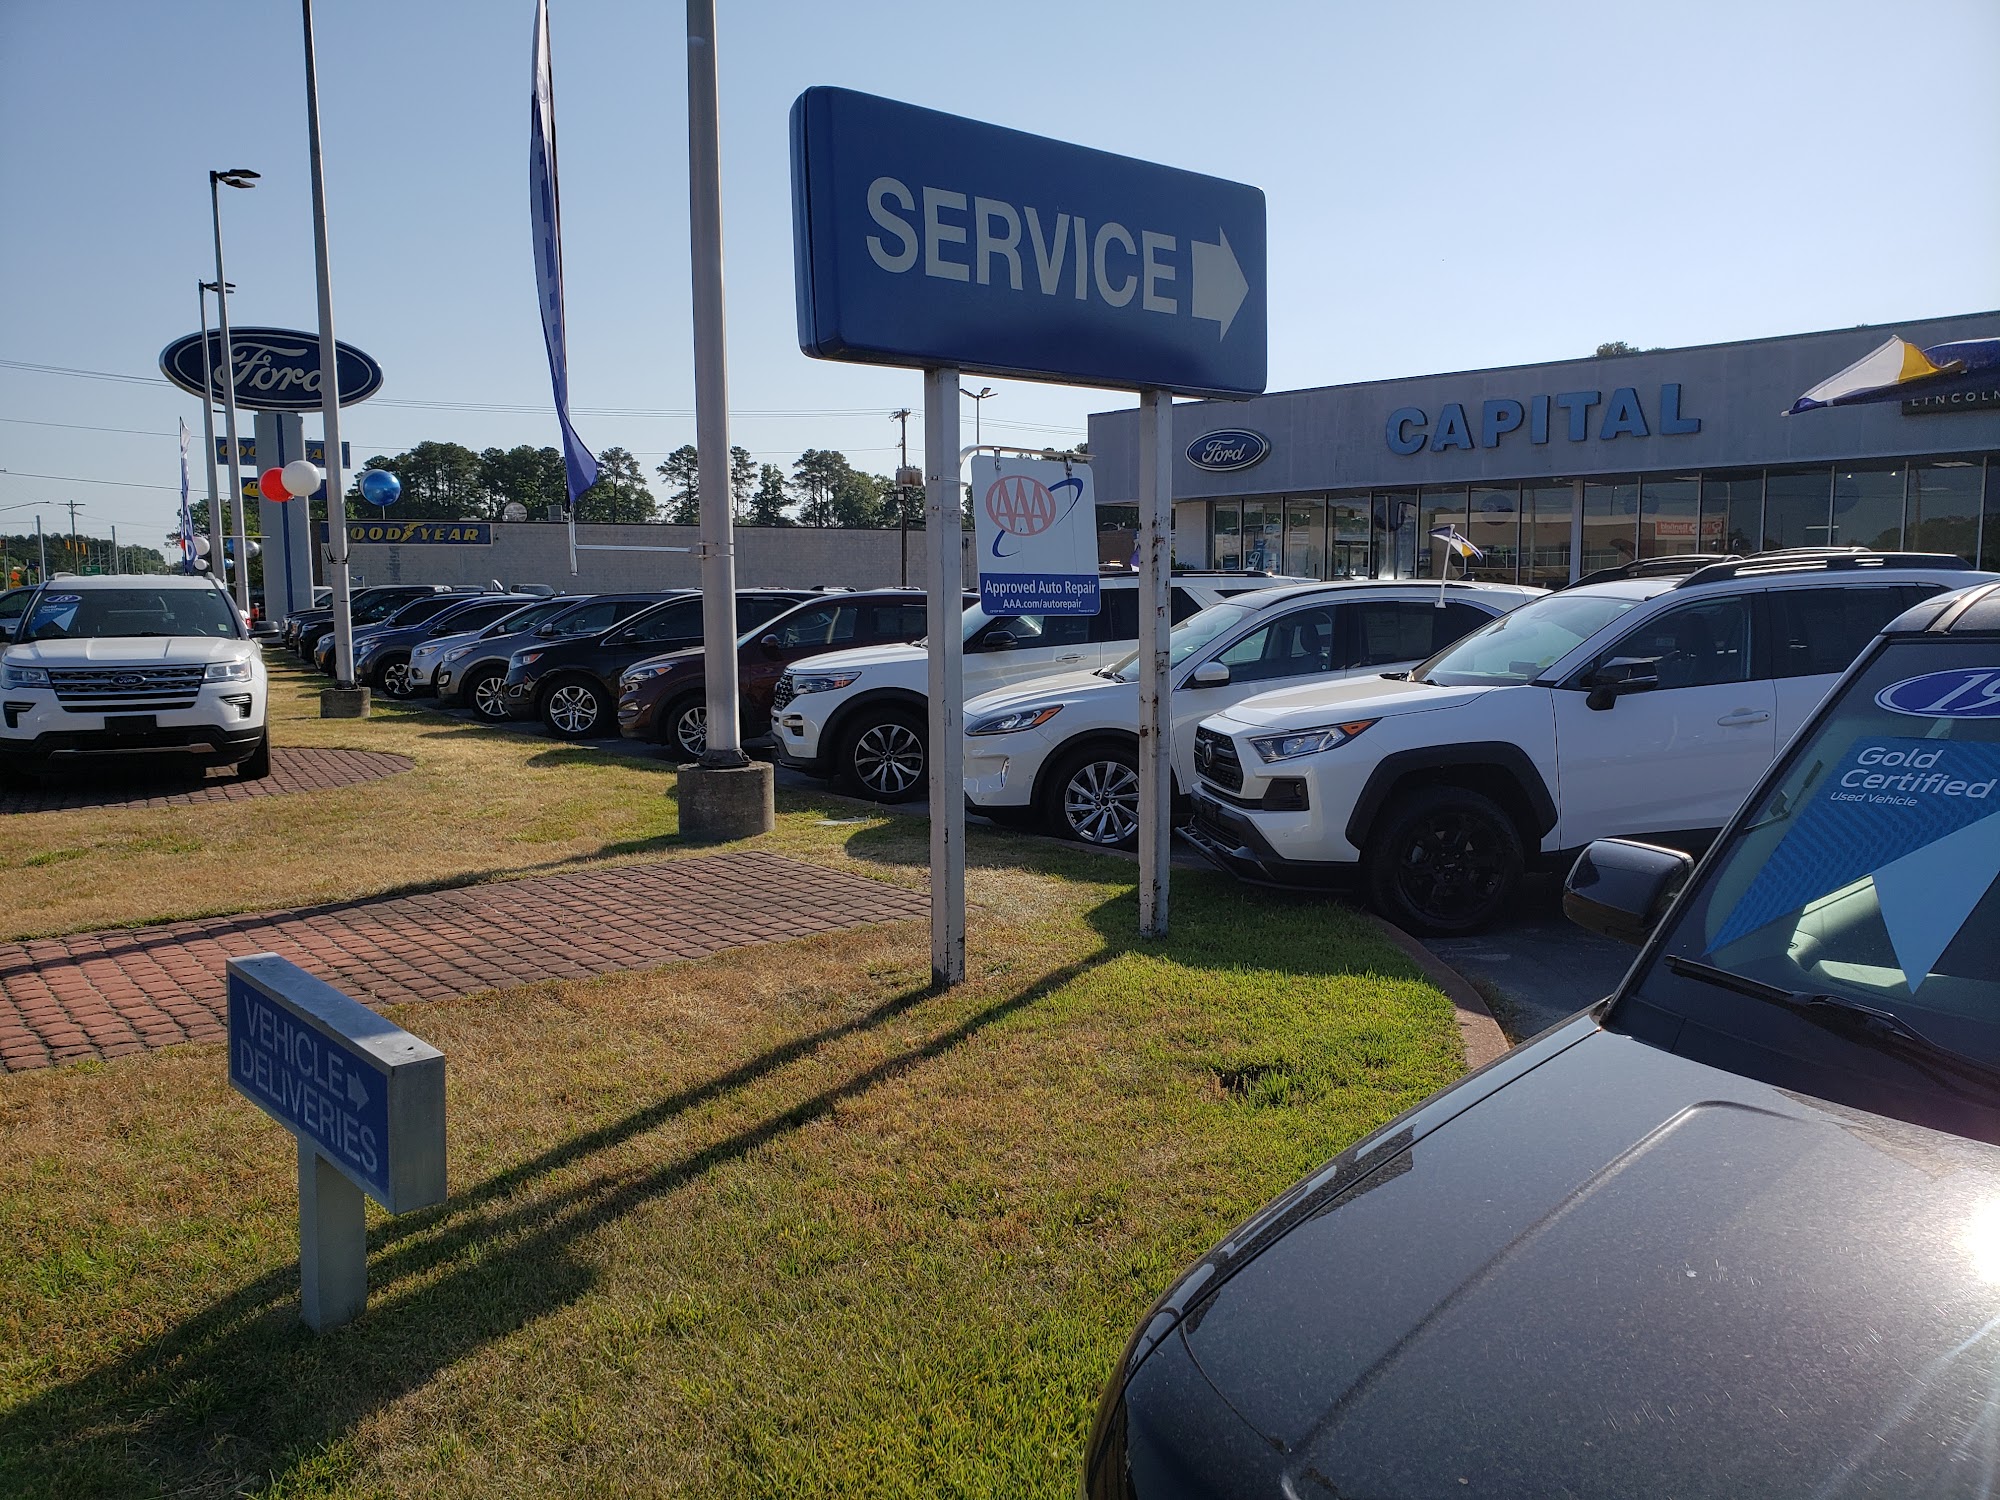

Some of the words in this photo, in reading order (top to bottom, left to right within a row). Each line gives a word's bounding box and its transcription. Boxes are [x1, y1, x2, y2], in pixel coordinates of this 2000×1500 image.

[866, 177, 1177, 315] SERVICE
[1386, 383, 1701, 455] CAPITAL
[1202, 440, 1246, 463] Ford
[994, 478, 1051, 534] AAA
[350, 526, 479, 541] OODYEAR
[985, 580, 1036, 597] Approved
[1038, 581, 1062, 594] Auto
[1065, 581, 1096, 597] Repair
[1003, 599, 1082, 610] AAA.com/autorepair
[1857, 747, 1944, 768] Gold
[1841, 769, 1997, 799] Certified
[1830, 791, 1865, 802] Used
[1868, 793, 1918, 806] Vehicle
[244, 995, 344, 1100] VEHICLE
[240, 1037, 378, 1174] DELIVERIES
